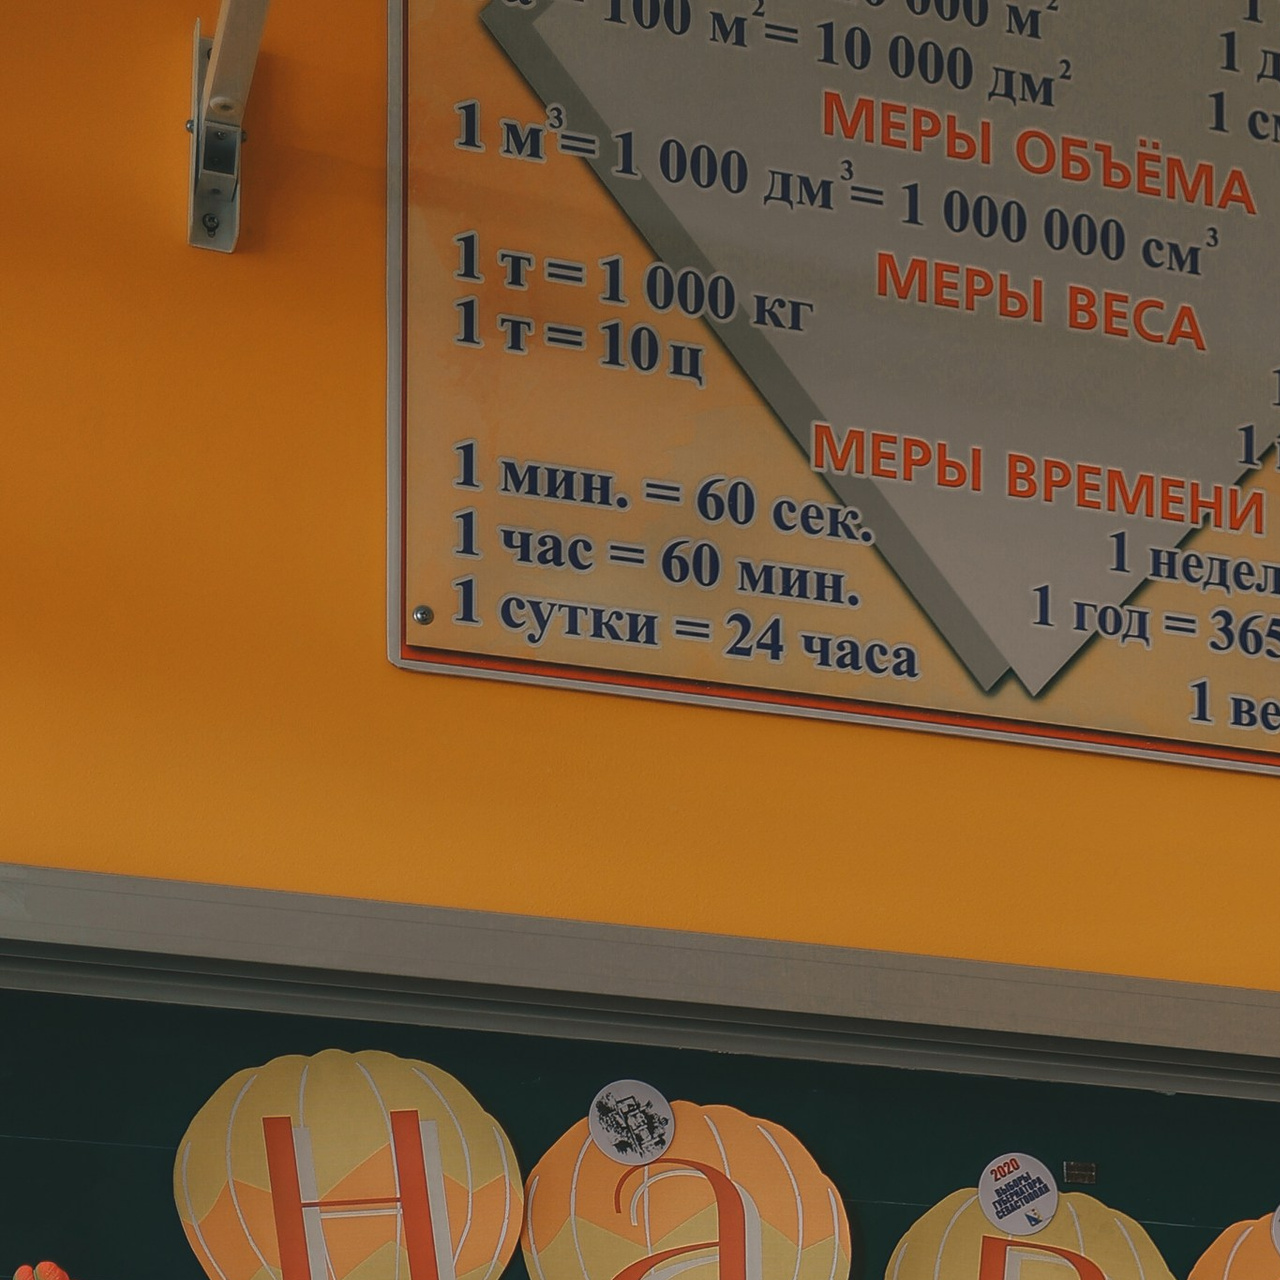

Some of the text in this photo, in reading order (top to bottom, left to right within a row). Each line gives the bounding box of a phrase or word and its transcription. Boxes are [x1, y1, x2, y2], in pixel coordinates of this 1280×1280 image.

[1220, 31, 1239, 72] 1
[457, 102, 482, 149] 1
[1208, 91, 1229, 133] 1
[824, 92, 1255, 213] МЕРЫ ОБЪЁМА
[456, 234, 481, 280] 1
[753, 294, 814, 332] кг
[877, 252, 1205, 350] МЕРЫ ВЕСА
[456, 299, 480, 345] 1
[1238, 424, 1259, 466] 1
[455, 442, 872, 542] 1 мин. 60 сек.
[814, 424, 1264, 534] МЕРЫ ВРЕМЕНИ
[455, 511, 859, 606] 1 час 60 мин.
[1109, 531, 1130, 573] 1
[455, 578, 919, 678] 1 сутки 24 часа
[1033, 584, 1054, 627] 1
[1073, 601, 1150, 645] год
[1191, 681, 1212, 722] 1
[989, 1156, 1021, 1183] 2020
[993, 1170, 1032, 1199] ВЫБОРЫ
[991, 1176, 1044, 1211] ГУБЕРНАТОРА
[994, 1182, 1051, 1220] СЕВАСТОПОЛЯ
